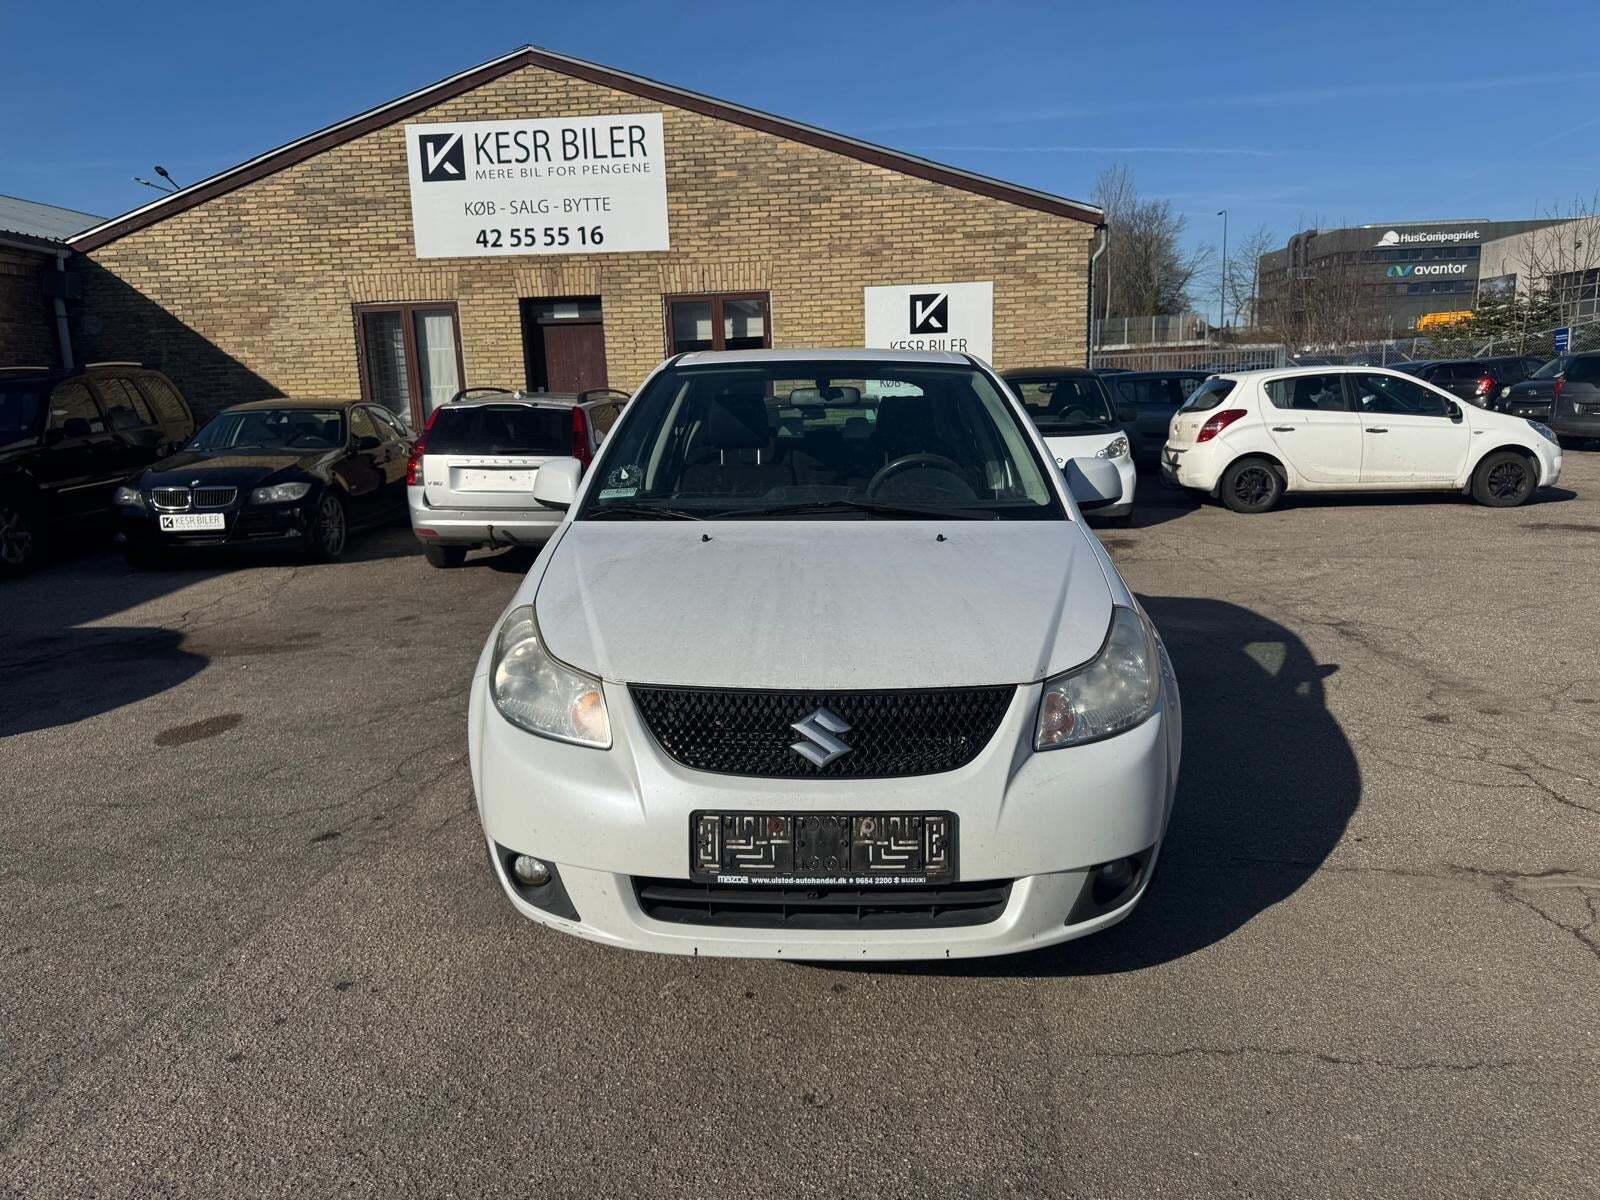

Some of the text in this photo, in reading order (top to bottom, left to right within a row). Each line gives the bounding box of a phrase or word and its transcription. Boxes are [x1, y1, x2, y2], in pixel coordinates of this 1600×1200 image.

[475, 125, 648, 165] KESR BILER
[475, 162, 652, 180] MERE BIL FOR PENGENE
[464, 201, 496, 216] KØB
[509, 199, 549, 214] SALG
[563, 197, 611, 213] BYTTE
[475, 225, 604, 248] 42 55 55 16
[1400, 231, 1480, 243] HusCompagniet
[1414, 263, 1468, 275] avantor
[175, 515, 220, 525] KESR BILER
